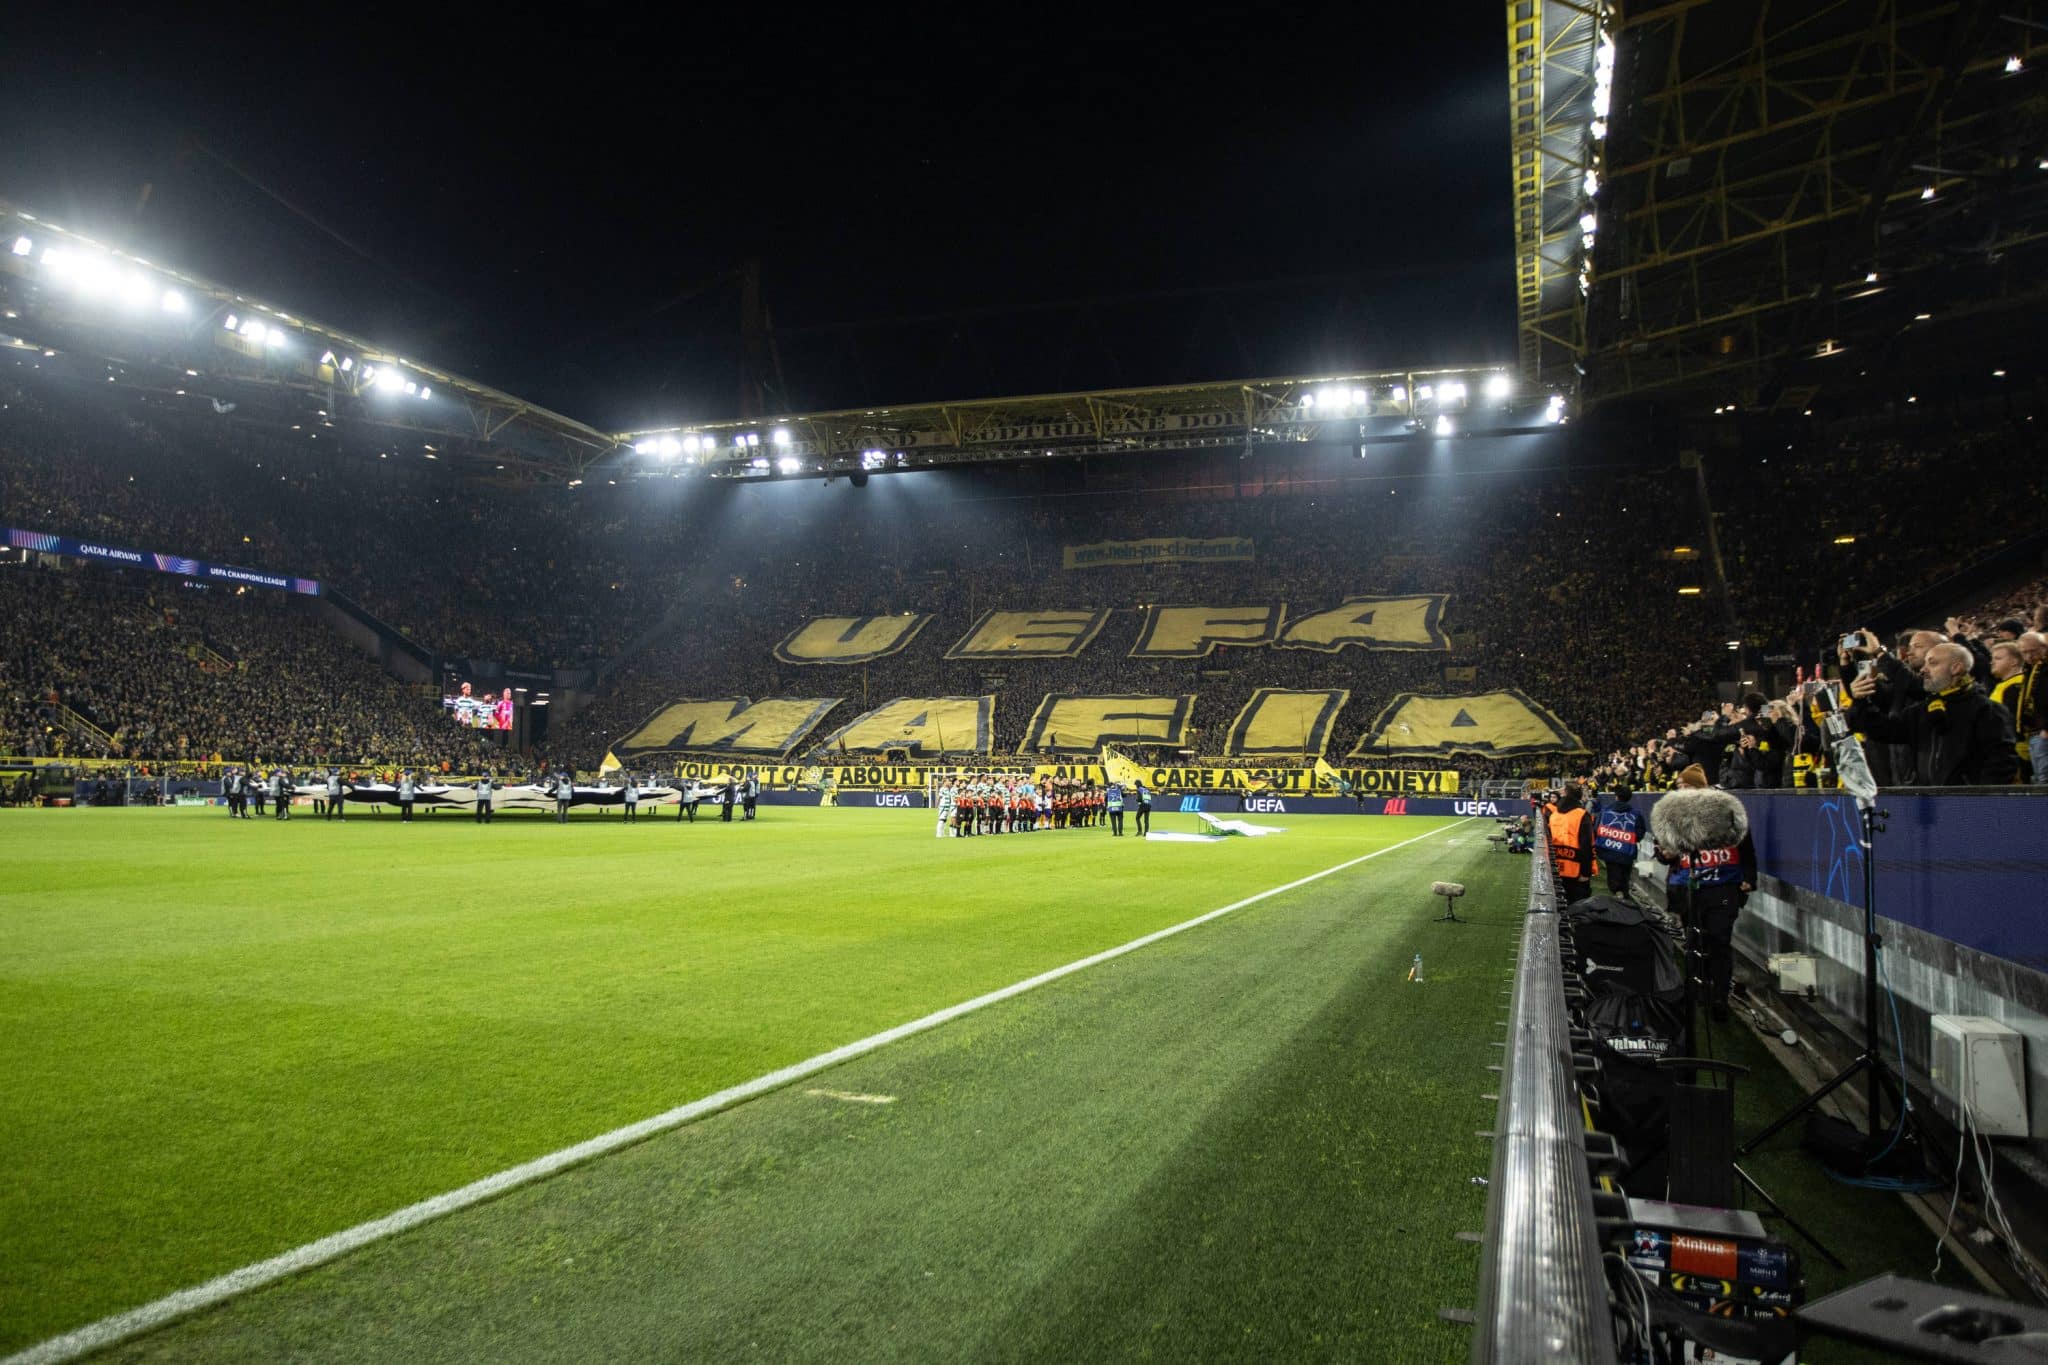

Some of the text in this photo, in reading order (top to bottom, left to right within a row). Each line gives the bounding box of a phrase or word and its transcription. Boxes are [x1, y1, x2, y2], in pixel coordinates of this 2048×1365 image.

[80, 544, 142, 562] QATAR AIRWAYS
[210, 567, 287, 587] UEFA CHAMPIONS LEAGUE
[773, 594, 1452, 664] UEFA
[607, 688, 1593, 760] MAFIA
[677, 762, 712, 780] YOU
[783, 766, 834, 785] CAE
[839, 766, 911, 785] ABOUT
[1152, 769, 1214, 788] CARE
[1340, 769, 1442, 792] MONEY!
[875, 794, 910, 807] UEFA
[1180, 797, 1200, 812] ALL
[1245, 799, 1285, 812] UEFA
[1384, 799, 1407, 815] ALL
[1454, 801, 1498, 816] UEFA
[1600, 826, 1632, 841] PHOTO
[1681, 848, 1731, 865] POTO
[1675, 1235, 1724, 1255] Xinhua
